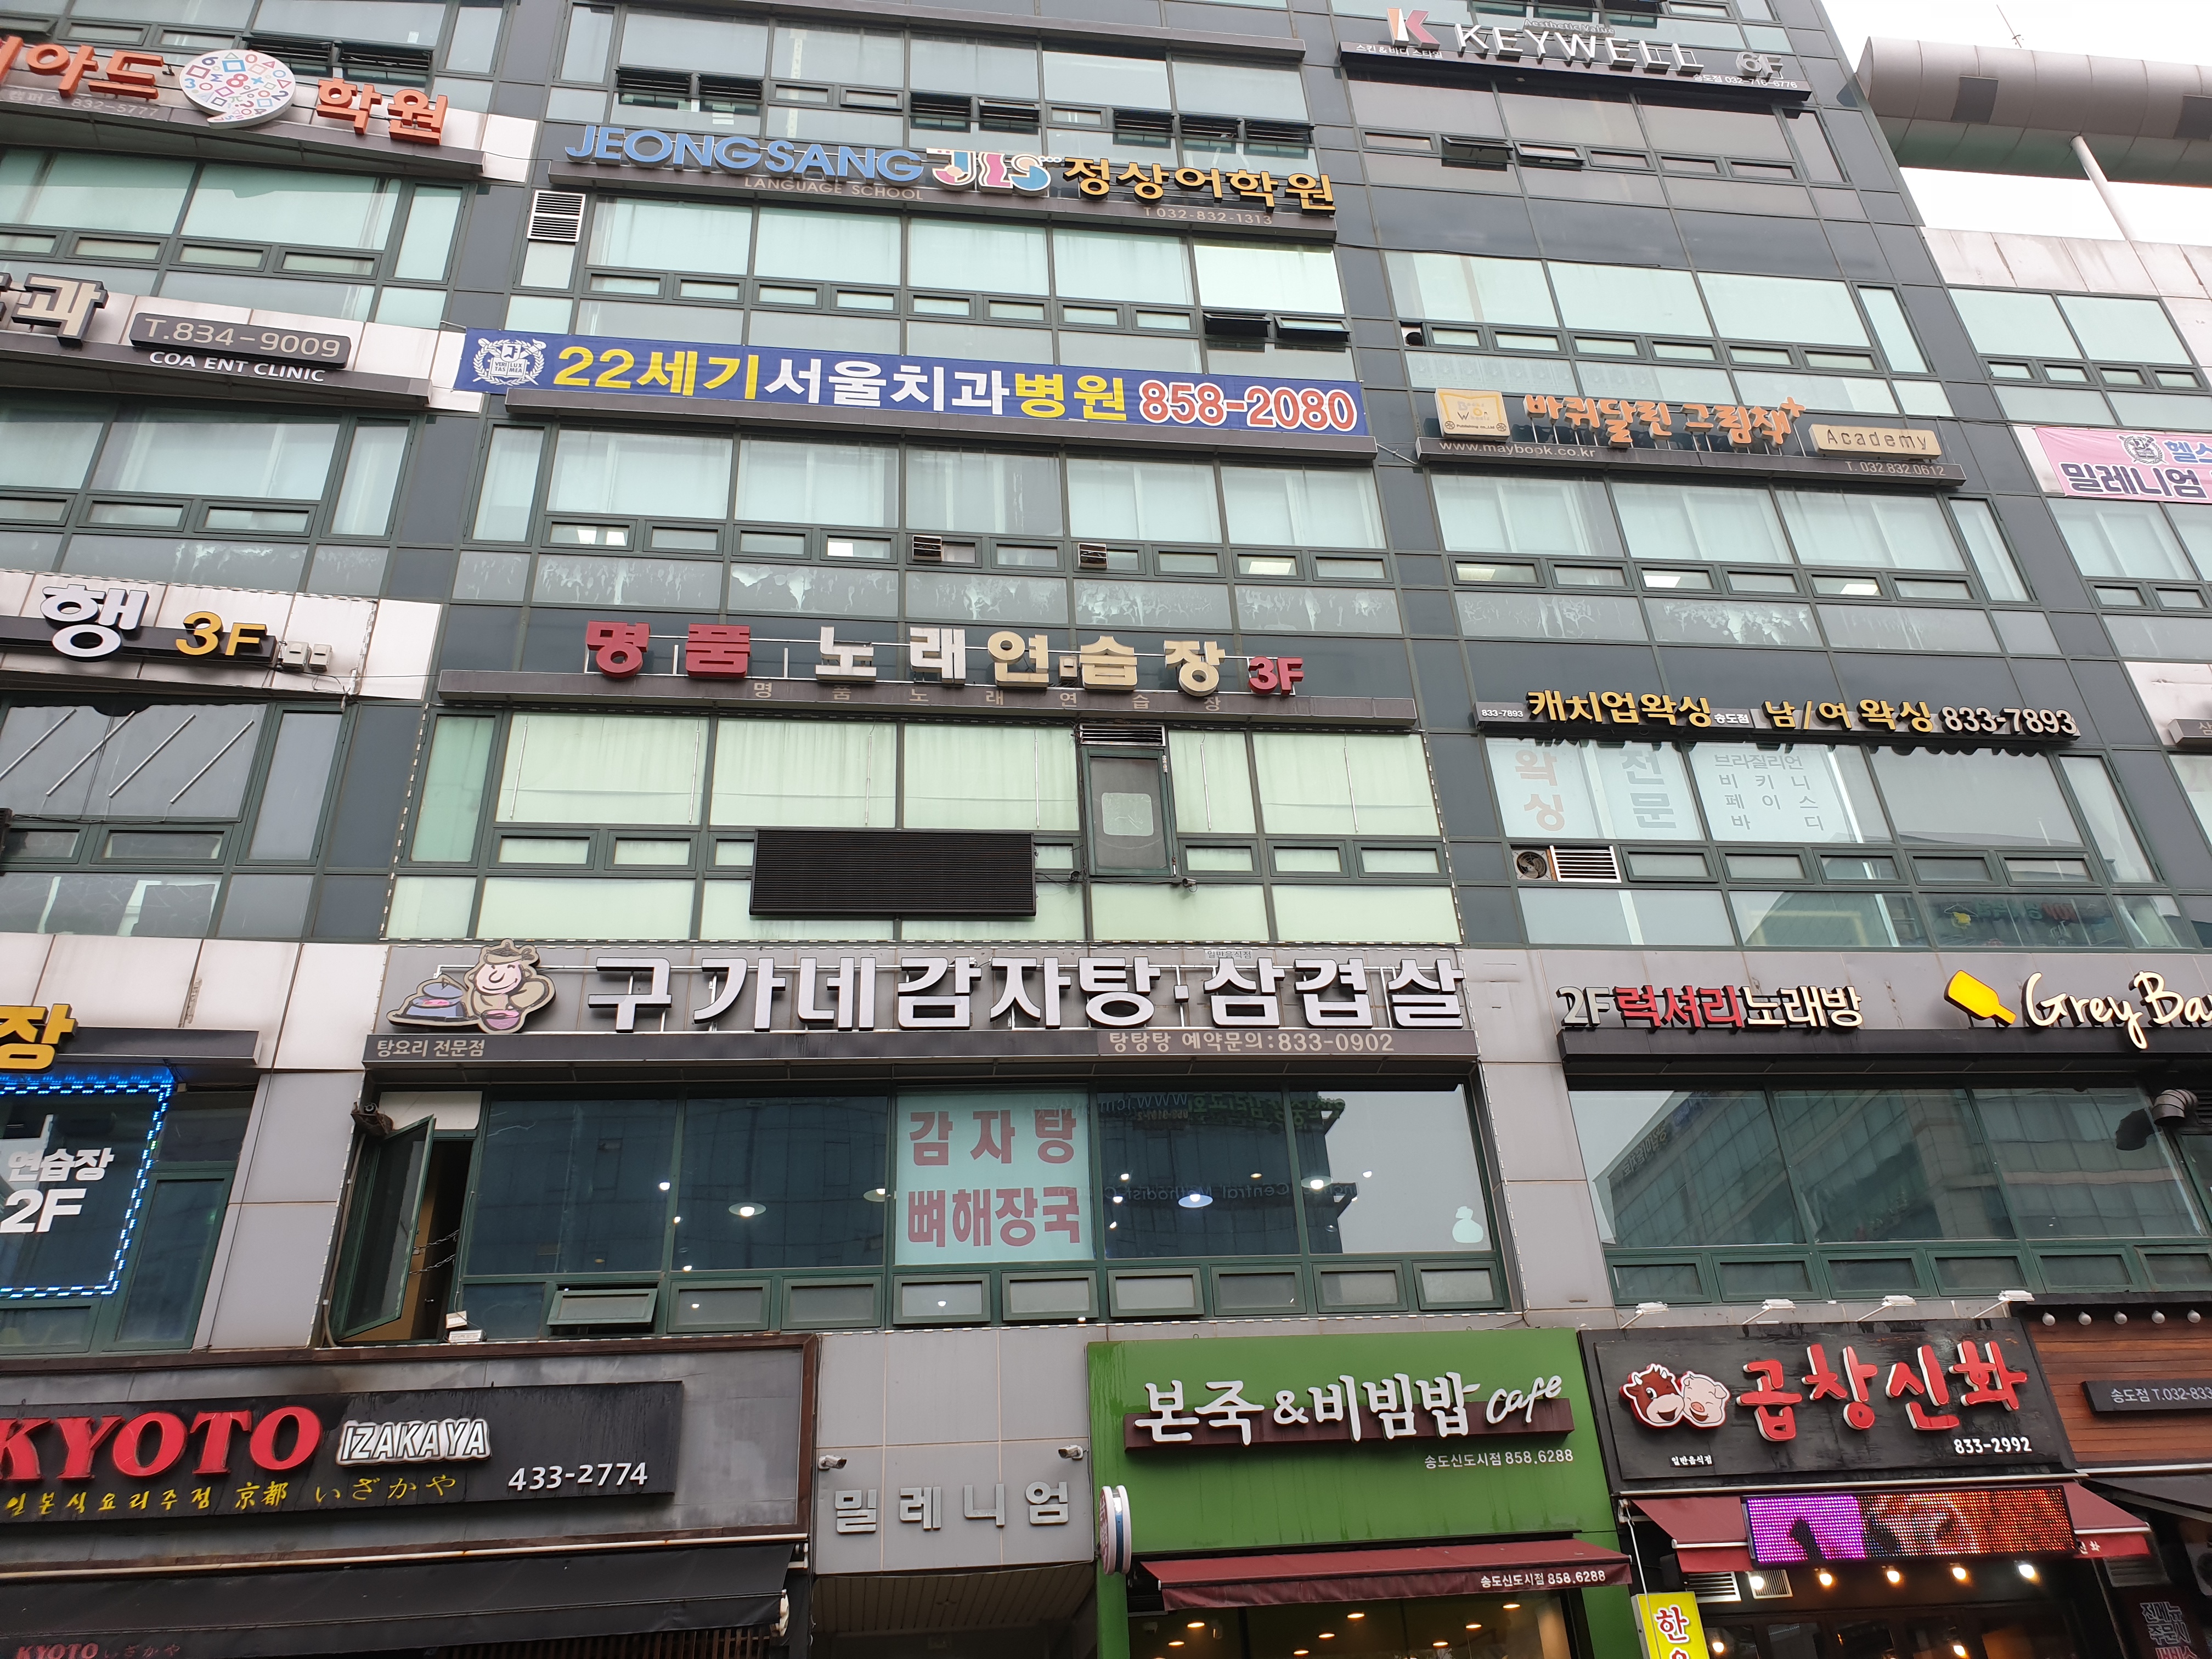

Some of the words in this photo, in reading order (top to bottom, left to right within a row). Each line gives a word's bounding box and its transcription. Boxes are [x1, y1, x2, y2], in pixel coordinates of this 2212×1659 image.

[1412, 48, 1443, 59] 스타일
[1454, 23, 1704, 72] KEYWELL
[1736, 52, 1783, 77] 6F
[0, 35, 163, 99] 아드
[317, 78, 448, 145] 학원
[1693, 74, 1723, 83] 송도점
[1725, 76, 1797, 88] 032-716-6776
[71, 99, 159, 117] 832-5777
[565, 125, 924, 187] JEONGSANG
[744, 177, 842, 195] LANGUAGE
[851, 184, 924, 201] SCHOOL
[1063, 156, 1336, 216] 정상어학원
[1156, 207, 1273, 226] 032-832-1313
[0, 273, 109, 348] 과
[144, 318, 340, 357] T.834-9009
[149, 352, 196, 370] COA
[203, 357, 248, 374] ENT
[253, 362, 326, 383] CLINIC
[1139, 380, 1358, 431] 858-2080
[1523, 394, 1672, 447] 바퀴달린
[1439, 442, 1595, 458] www.maybook.co.kr
[1826, 428, 1927, 450] Academy
[2061, 464, 2207, 498] 밀레니엄
[40, 584, 150, 662] 행
[175, 611, 268, 657] 3F
[1248, 656, 1305, 696] 3F
[1481, 709, 1523, 718] 833-7893
[1526, 690, 1712, 728] 캐치업왁싱
[1714, 713, 1750, 724] 송도점
[1857, 698, 1934, 735] 왁싱
[1939, 706, 2078, 738] 833-7893
[1714, 753, 1804, 770] 브라질리언
[1207, 951, 1251, 959] 일반음식점
[2129, 970, 2212, 1025] Ba
[0, 1003, 77, 1069] 장
[377, 1040, 427, 1057] 탕요리
[433, 1040, 485, 1057] 전문점
[1109, 1032, 1171, 1052] 탕탕탕
[910, 1109, 1076, 1166] 감자탕
[8, 1148, 114, 1182] 연습장
[0, 1188, 87, 1233] 2F
[908, 1187, 1080, 1248] 뼈해장국
[1736, 1340, 2028, 1442] 곱창신화
[2111, 1387, 2151, 1404] 송도점
[0, 1405, 323, 1482] KYOTO
[339, 1419, 490, 1464] IZAKAYA
[1424, 1452, 1502, 1470] 송도신도시점
[1505, 1449, 1574, 1466] 858.6288
[1954, 1436, 2032, 1455] 833-2992
[1671, 1455, 1713, 1466] 일반음식점
[507, 1462, 649, 1492] 433-2774
[235, 1480, 289, 1510] 京都
[1480, 1572, 1544, 1588] 송도신도시점
[1547, 1570, 1606, 1585] 858.6288
